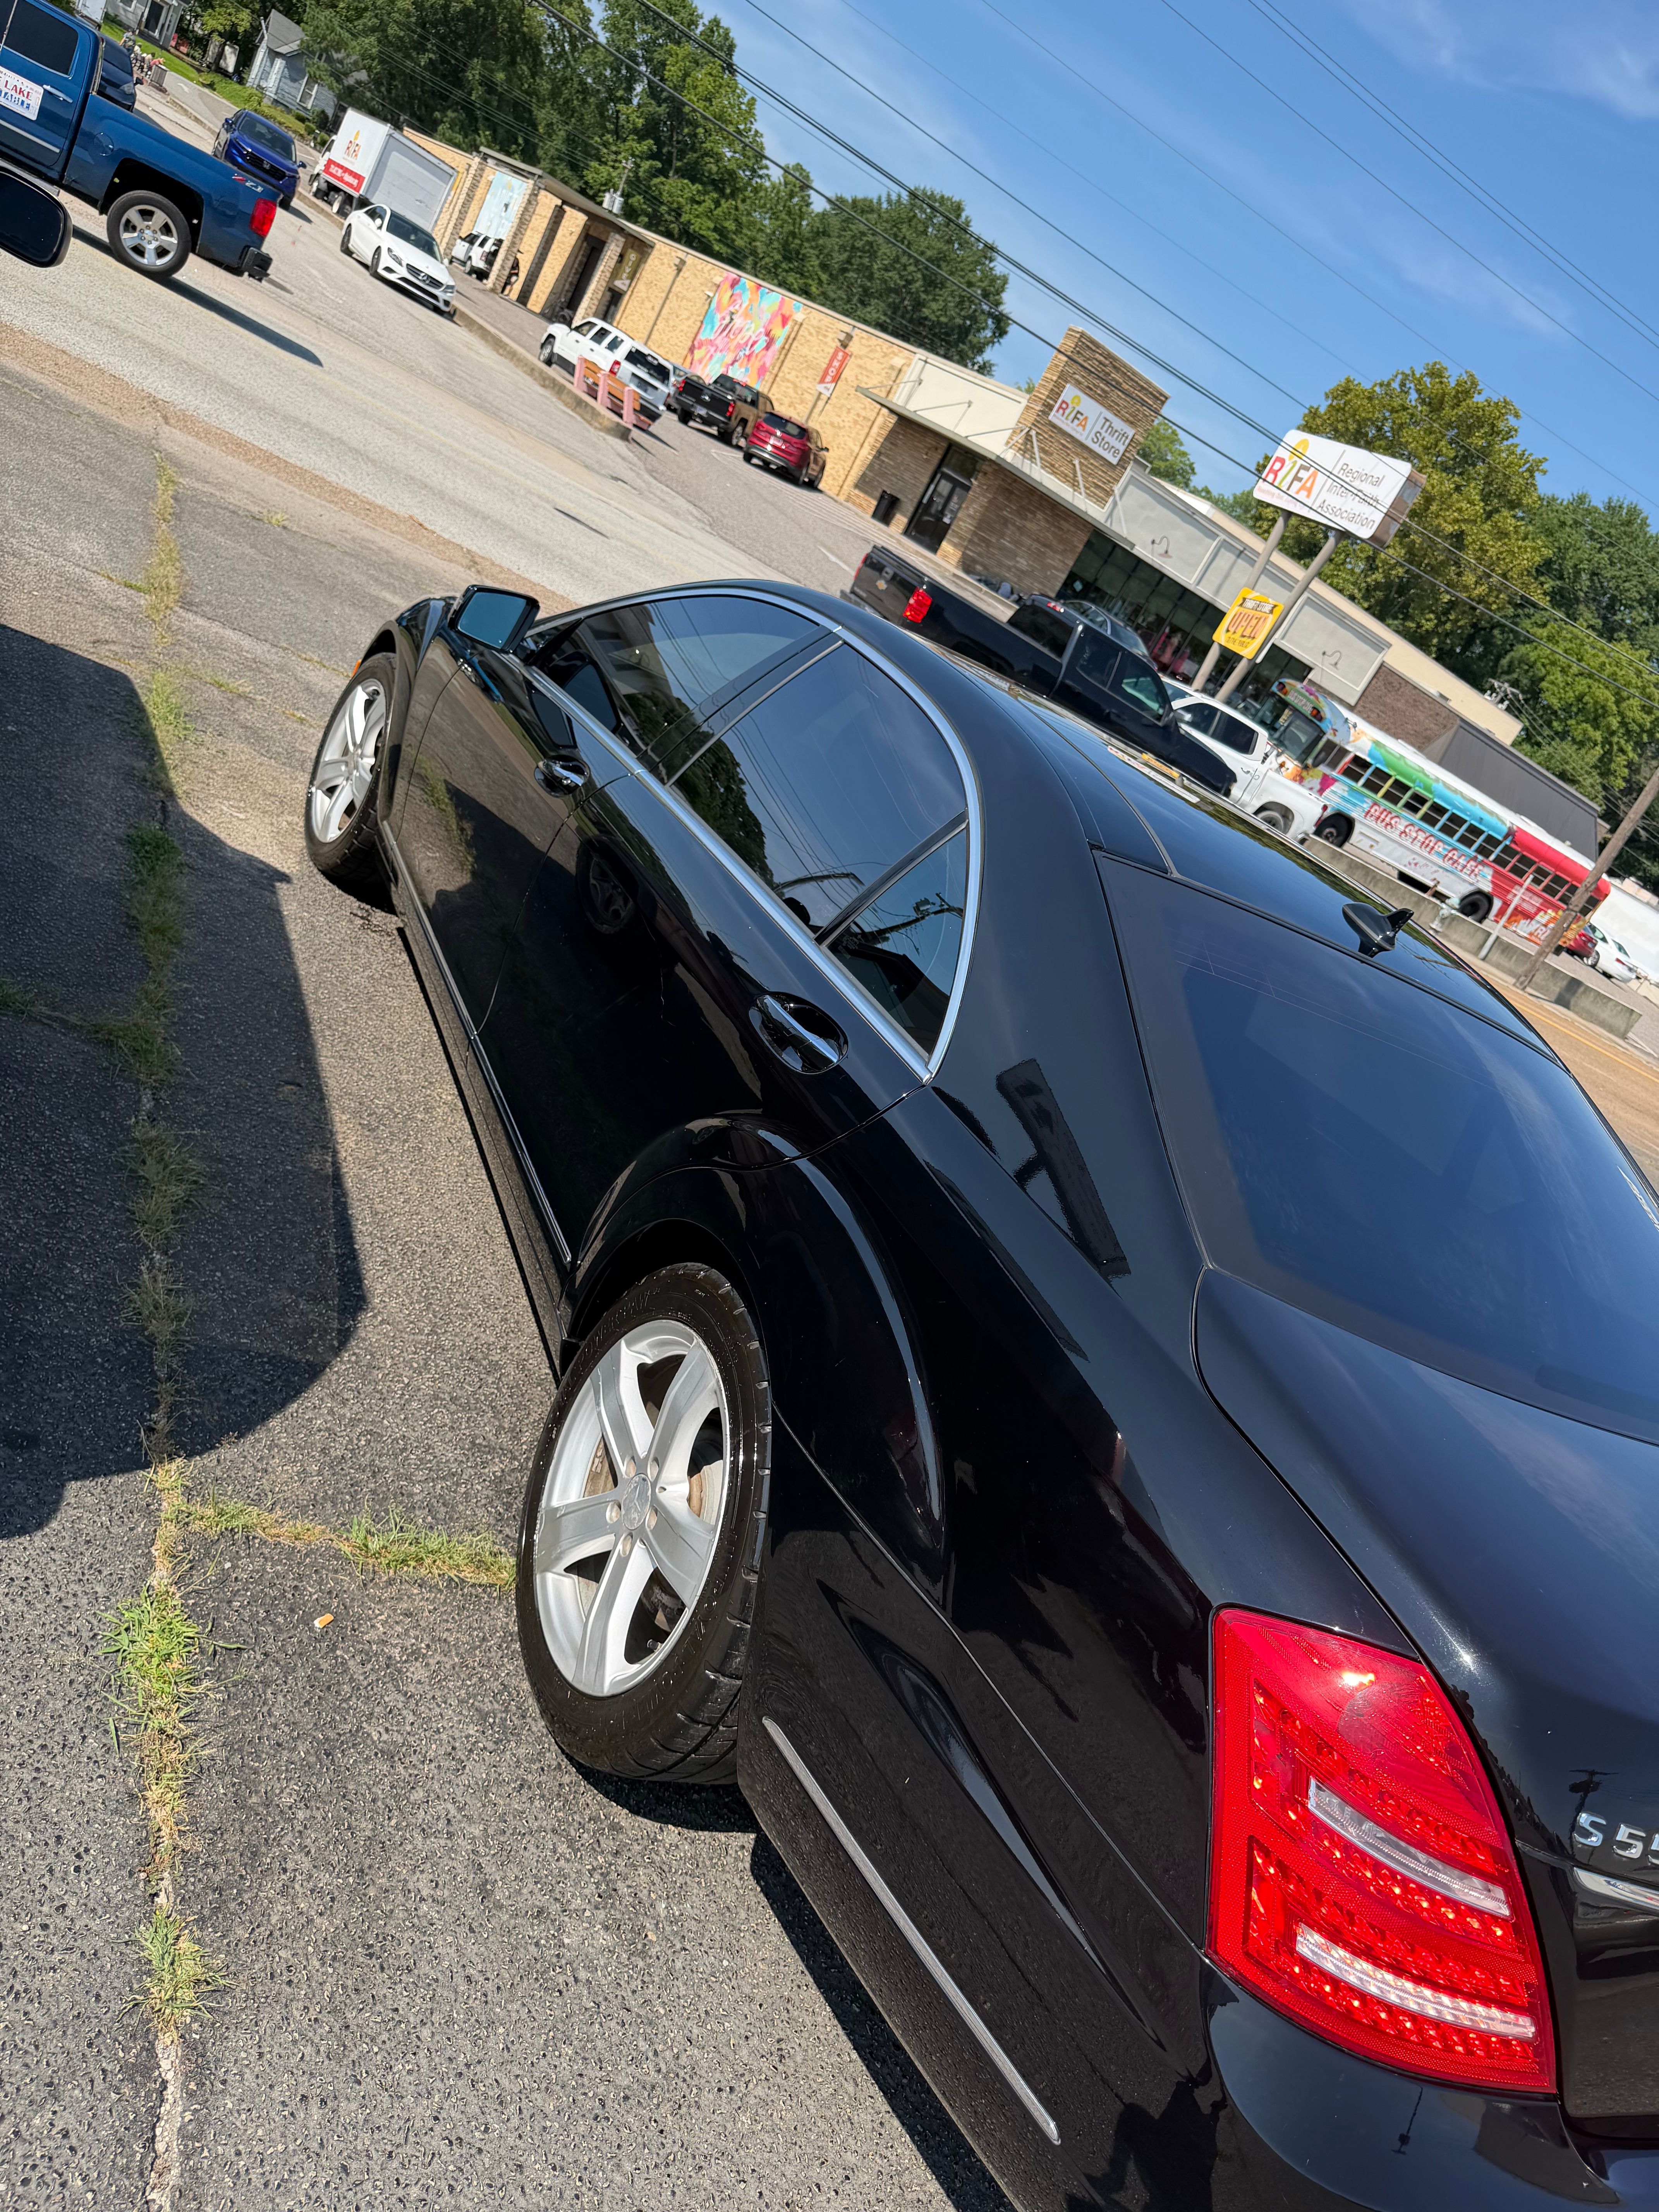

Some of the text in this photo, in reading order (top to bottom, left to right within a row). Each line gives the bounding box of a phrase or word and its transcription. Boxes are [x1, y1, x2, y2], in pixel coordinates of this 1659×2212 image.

[4, 80, 33, 101] LAKE
[824, 352, 845, 382] SHOP
[1091, 431, 1120, 458] Store
[1100, 416, 1130, 446] Thrift
[1338, 462, 1386, 488] Regional
[1317, 498, 1376, 530] Association
[1227, 610, 1269, 639] OPEN
[1364, 802, 1401, 829] BUS
[1398, 823, 1444, 855] STOP
[1572, 1811, 1607, 1847] S
